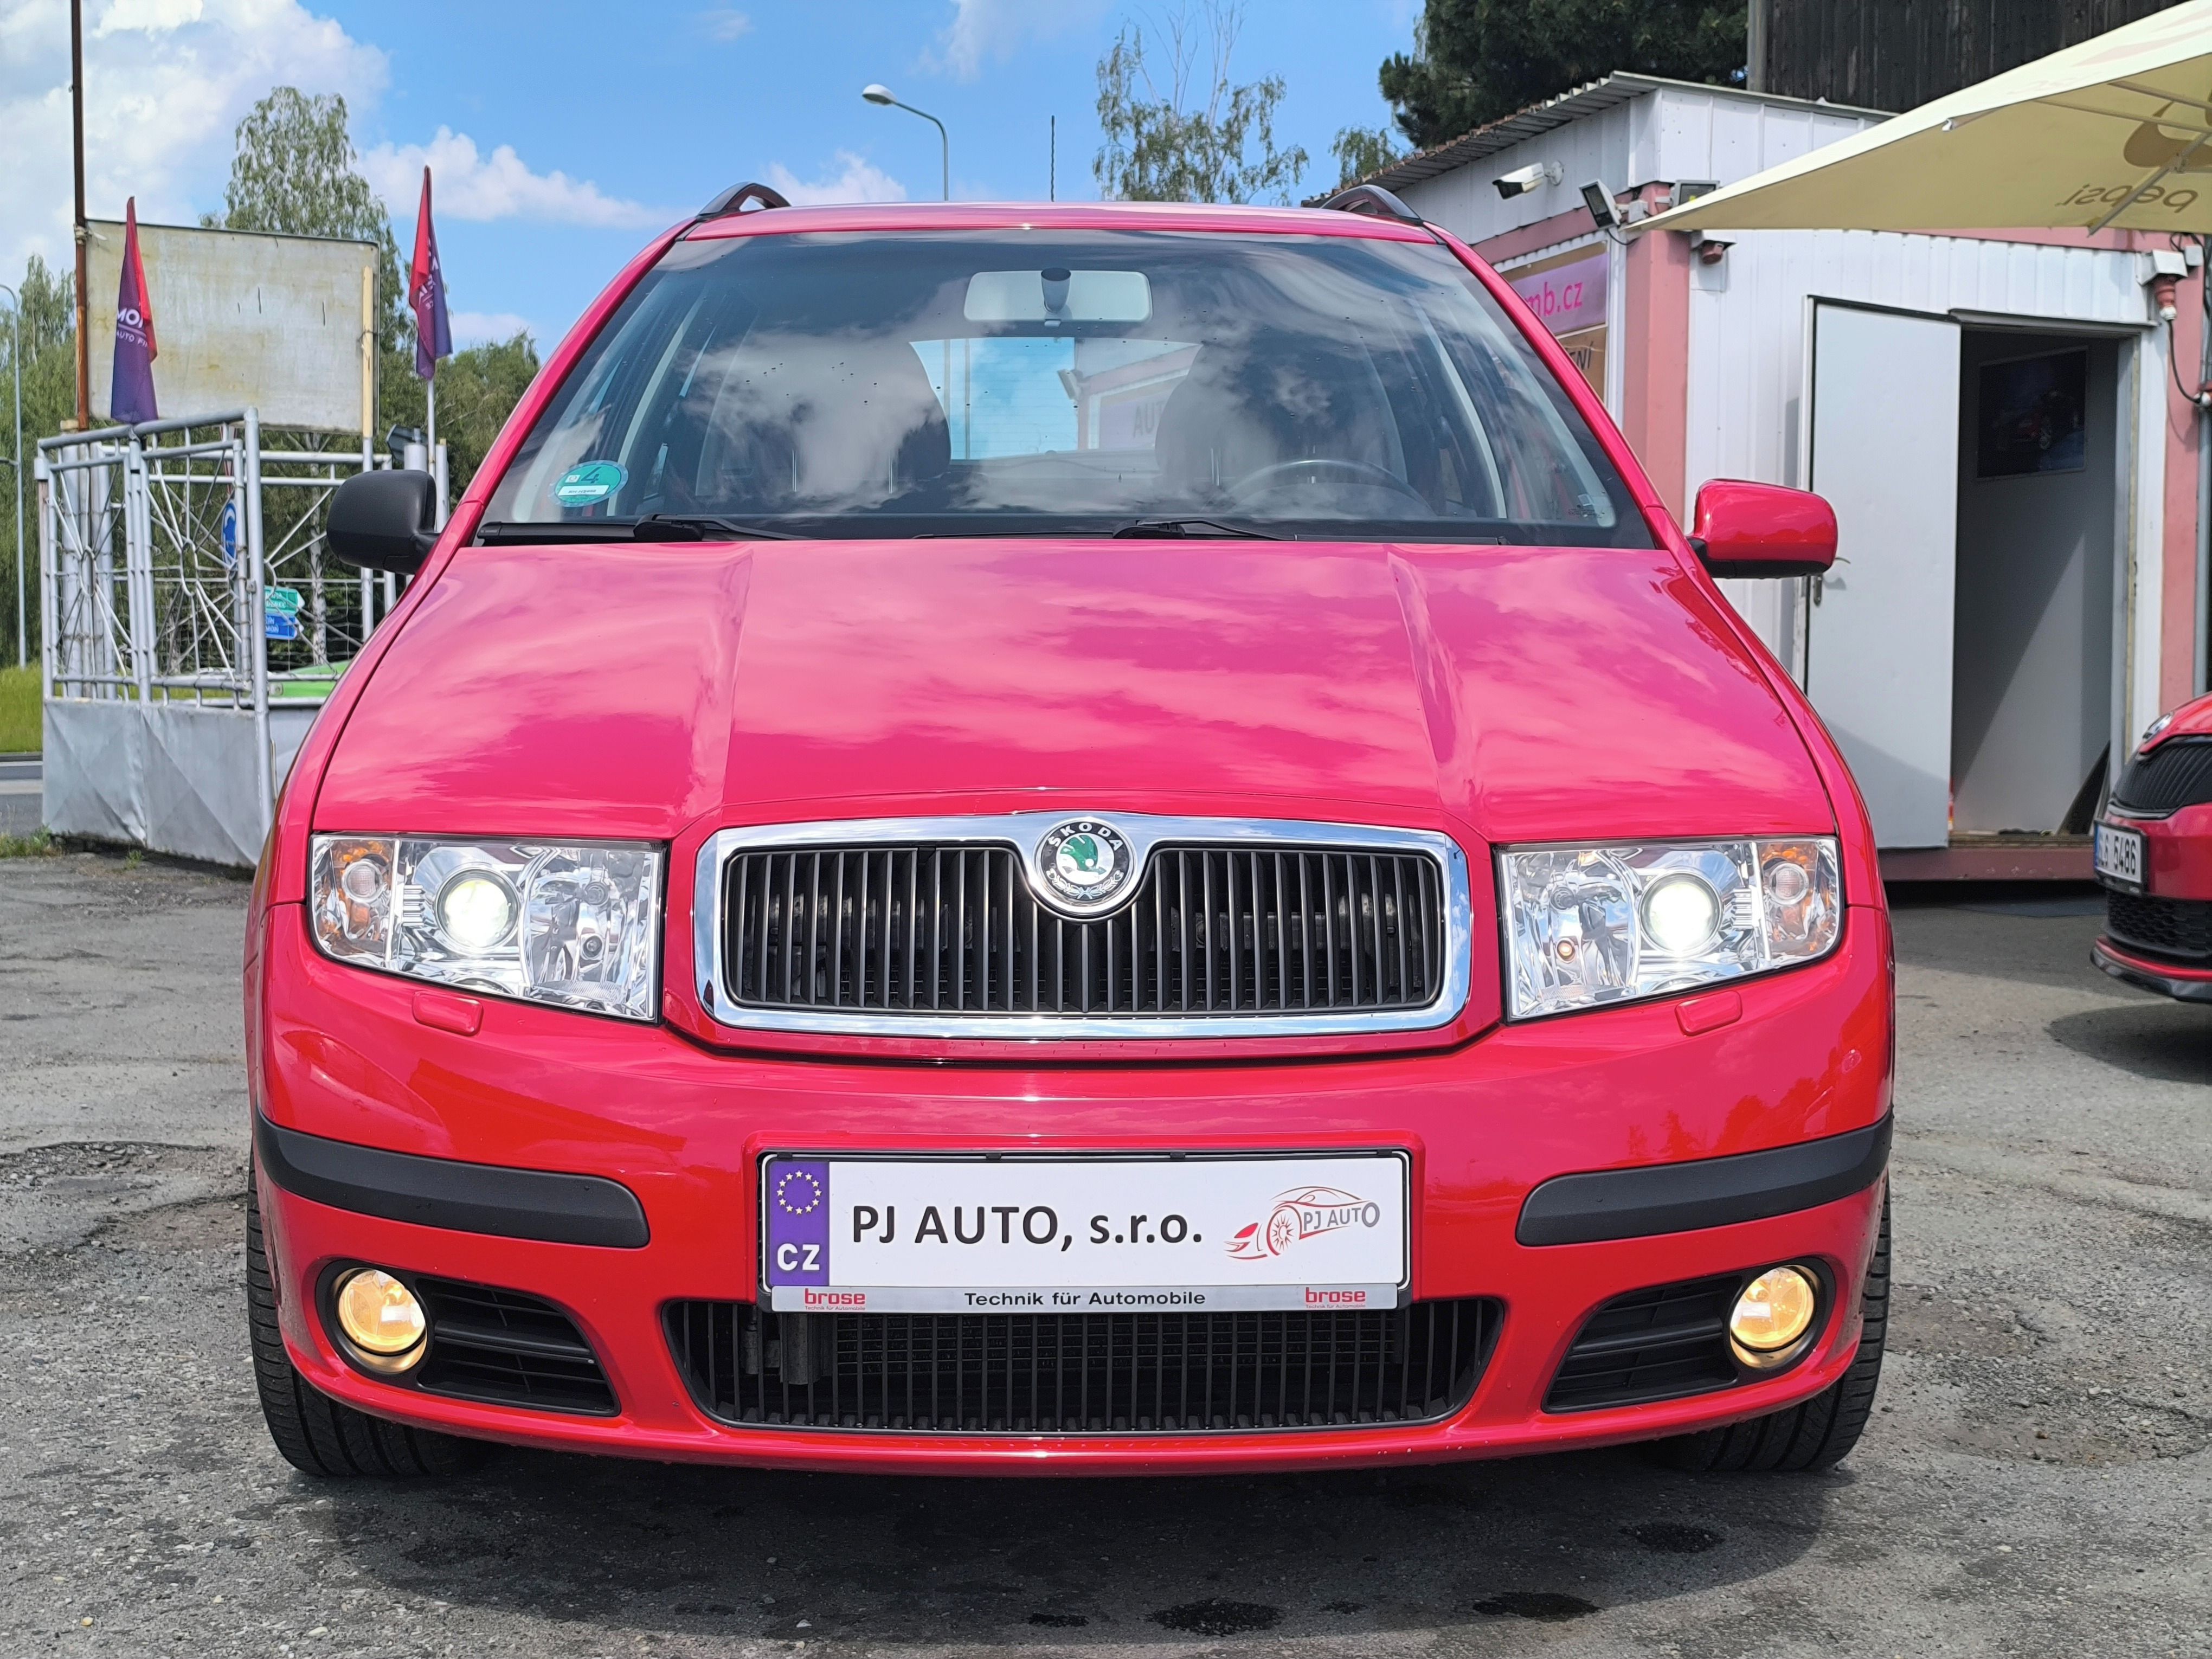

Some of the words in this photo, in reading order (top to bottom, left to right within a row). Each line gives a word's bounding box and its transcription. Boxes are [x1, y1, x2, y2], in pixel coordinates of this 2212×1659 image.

[581, 466, 602, 484] 4
[1048, 822, 1123, 852] ŠKODA
[2114, 835, 2136, 875] 5486
[853, 1206, 895, 1243] PJ
[915, 1206, 1072, 1251] AUTO,
[1090, 1214, 1202, 1243] s.r.o.
[1303, 1211, 1321, 1231] PJ
[1327, 1202, 1380, 1228] AUTO
[777, 1243, 820, 1270] CZ
[805, 1288, 865, 1304] brose
[964, 1293, 1044, 1306] Technik
[1052, 1292, 1081, 1306] für
[1089, 1291, 1206, 1306] Automobile
[1306, 1287, 1366, 1303] brose
